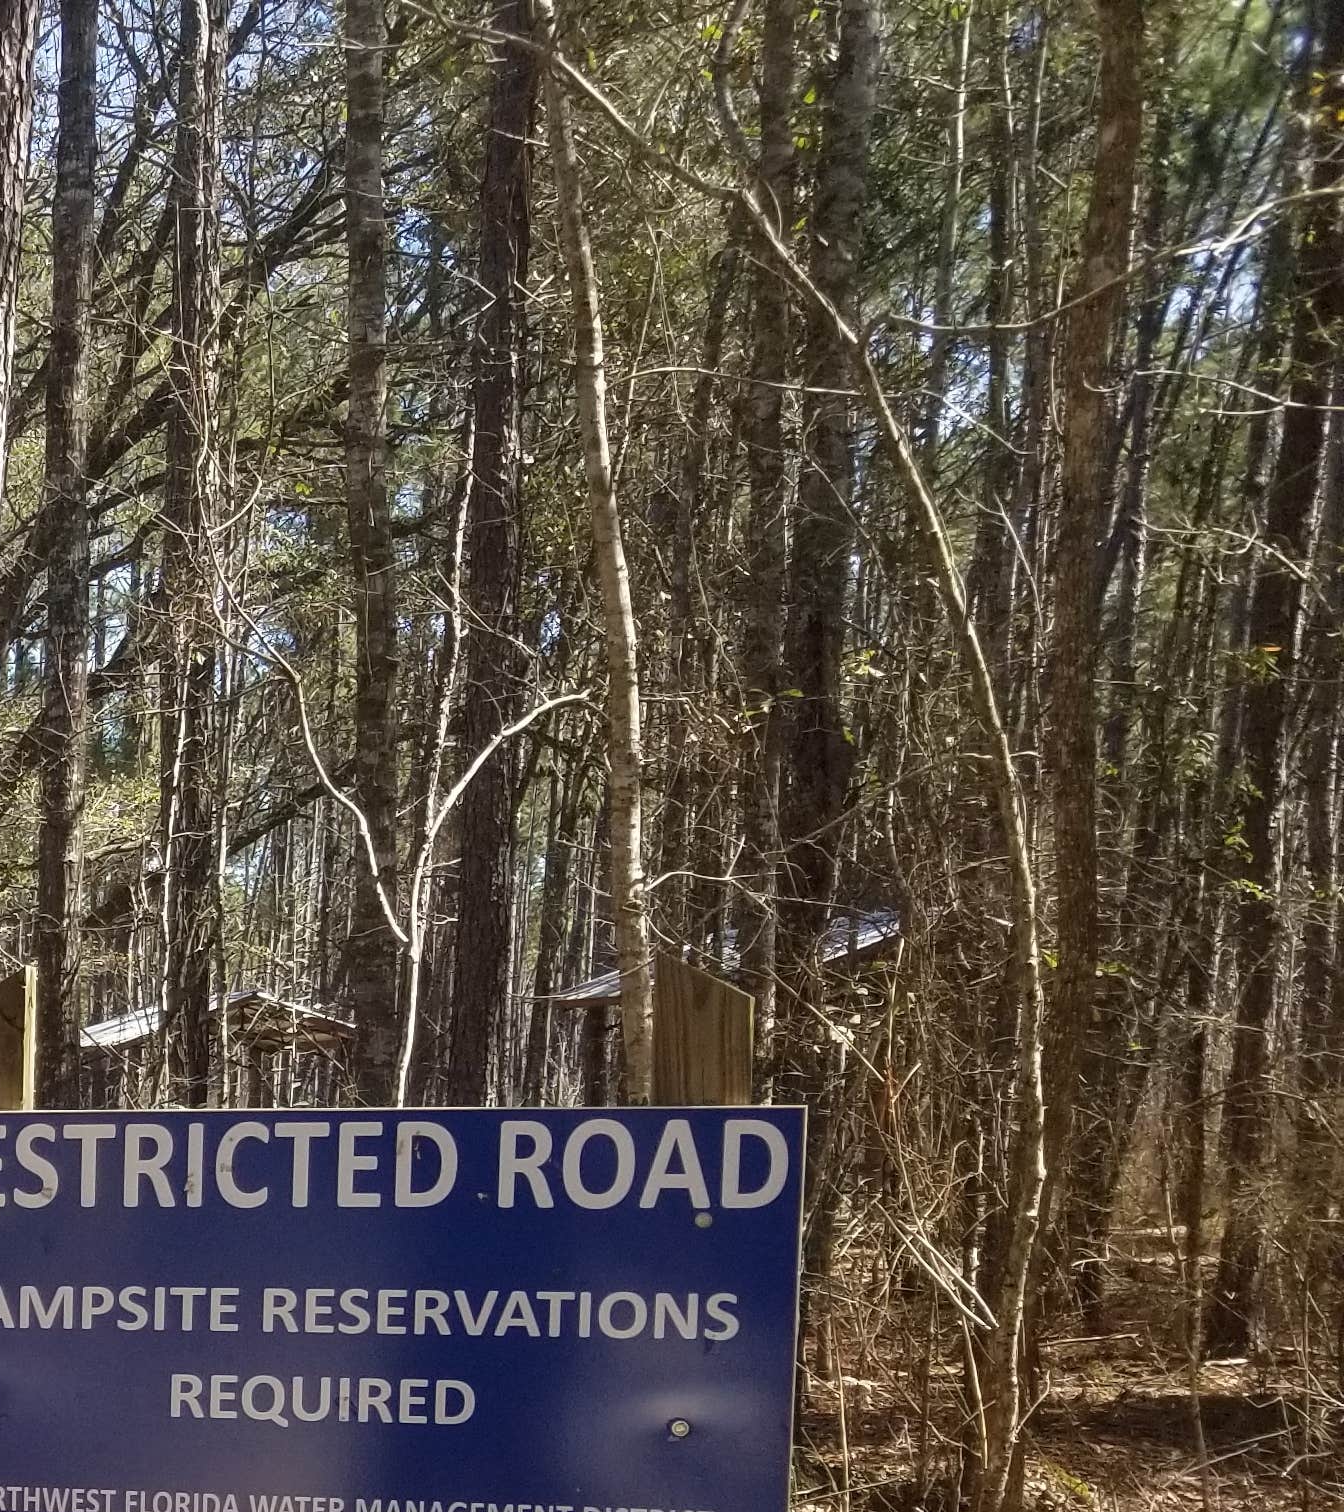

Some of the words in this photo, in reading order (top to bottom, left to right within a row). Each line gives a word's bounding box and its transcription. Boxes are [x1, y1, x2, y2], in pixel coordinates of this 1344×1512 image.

[498, 1119, 788, 1209] ROAD
[263, 1288, 739, 1340] RESERVATIONS
[171, 1374, 475, 1427] REQUIRED
